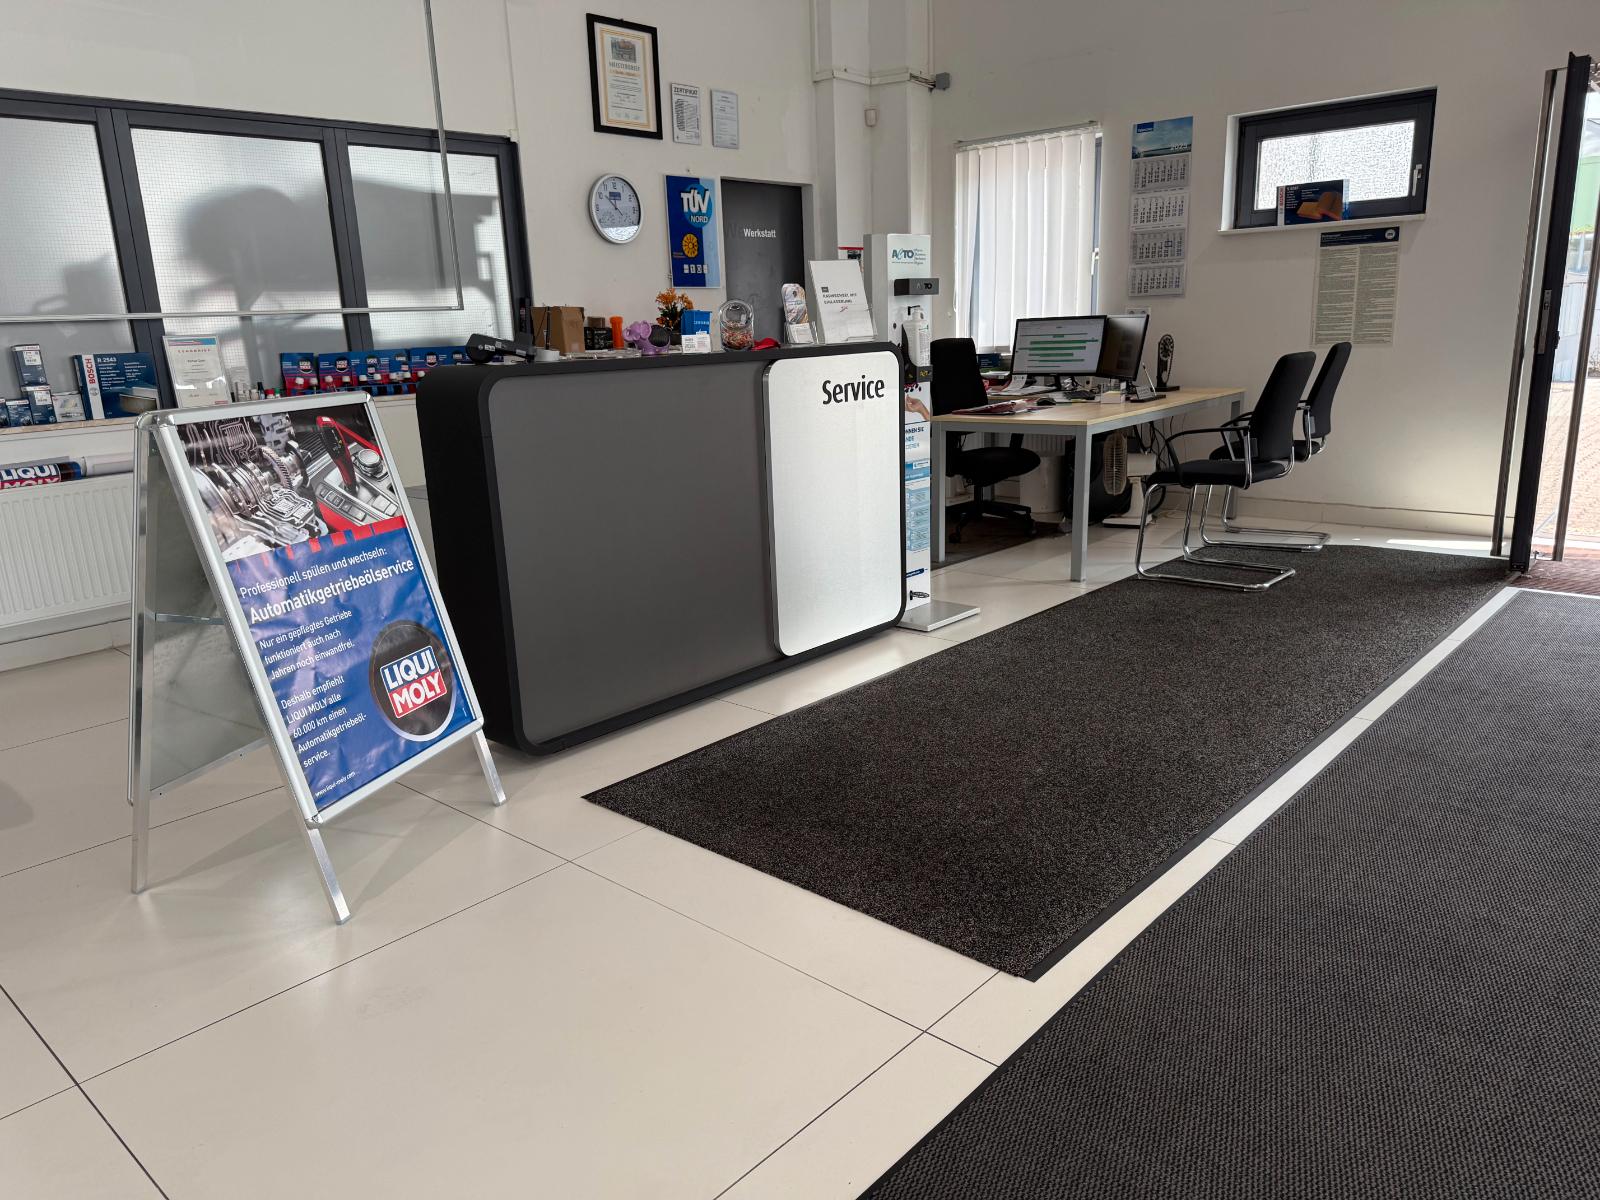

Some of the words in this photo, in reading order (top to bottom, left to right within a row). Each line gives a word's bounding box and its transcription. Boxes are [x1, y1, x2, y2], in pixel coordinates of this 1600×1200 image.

[680, 188, 710, 214] TÜV
[690, 215, 709, 224] NORD
[743, 228, 777, 239] Werkstatt
[85, 358, 96, 385] BOSCH
[822, 375, 885, 404] Service
[0, 464, 57, 480] LIQUI
[240, 574, 301, 599] Professionell
[301, 564, 330, 581] spülen
[332, 559, 348, 572] und
[348, 547, 387, 565] wechseln:
[249, 559, 414, 623] Automatikgetriebeölservice
[259, 637, 274, 649] Nur
[276, 633, 287, 644] ein
[288, 619, 324, 642] gepflegtes
[325, 610, 352, 627] Getriebe
[264, 640, 307, 665] funktioniert
[308, 635, 321, 648] auch
[322, 629, 341, 644] nach
[270, 665, 295, 681] Jahren
[297, 656, 314, 669] noch
[315, 640, 355, 662] einwandfrei.
[383, 650, 435, 689] LIQUI
[280, 691, 311, 709] Deshalb
[313, 676, 344, 698] empfiehlt
[287, 708, 307, 723] LIQUI
[308, 700, 327, 714] MOLY
[328, 693, 341, 706] alle
[391, 672, 442, 713] MOLY
[293, 722, 316, 738] 60.000
[317, 715, 329, 727] km
[329, 706, 347, 720] einen
[298, 713, 367, 753] Automatikgetriebeöl-
[303, 749, 330, 767] service.
[315, 770, 355, 798] www.liqui-moly.com
